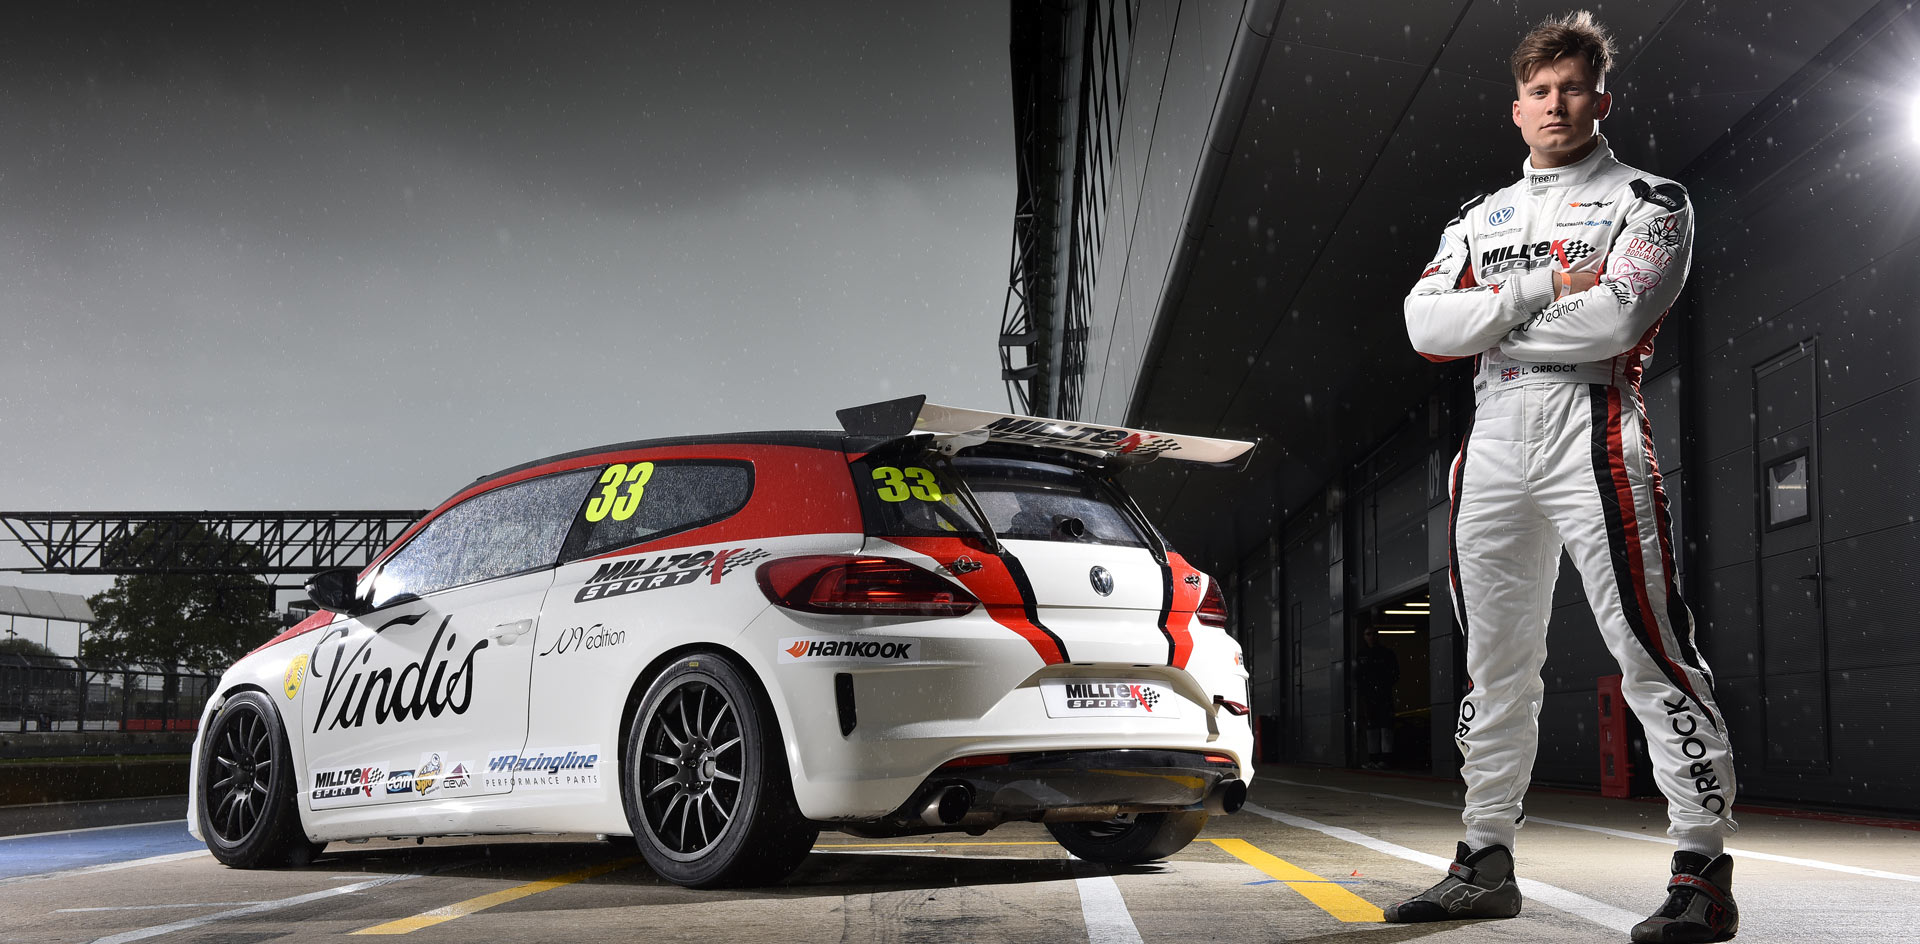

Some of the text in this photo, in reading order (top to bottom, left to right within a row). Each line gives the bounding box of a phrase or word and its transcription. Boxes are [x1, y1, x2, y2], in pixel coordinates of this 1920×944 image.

[1629, 237, 1672, 265] ORACLE
[1484, 258, 1548, 276] SPOT
[1545, 298, 1584, 323] edition
[1521, 364, 1577, 376] L. ORROCK
[871, 466, 942, 502] 33
[1428, 448, 1441, 500] 09
[585, 462, 655, 523] 33
[582, 570, 691, 600] SPORT
[585, 626, 626, 650] edition
[310, 609, 489, 734] Vindis
[1072, 700, 1131, 708] SPORT
[499, 751, 598, 775] Racingline
[1663, 695, 1726, 815] ORROCK
[315, 787, 356, 799] SPORT
[485, 775, 598, 787] PERFORMANCE PARTS
